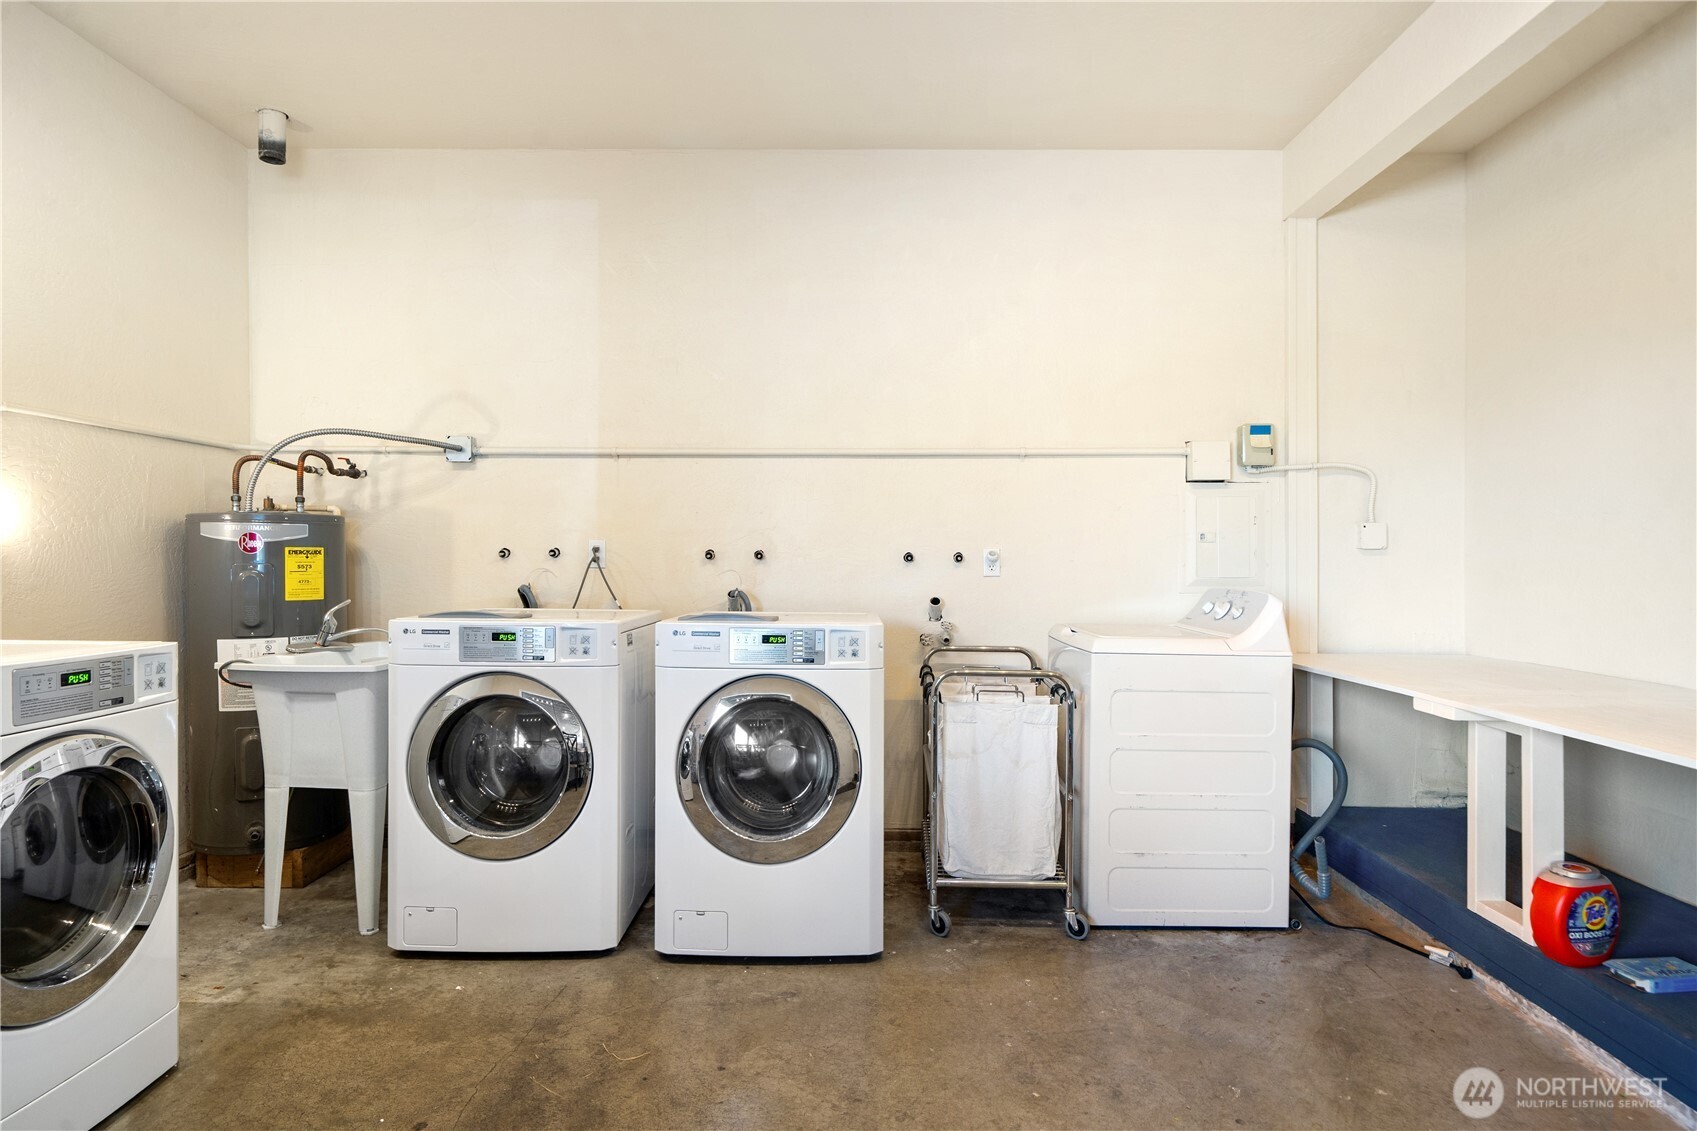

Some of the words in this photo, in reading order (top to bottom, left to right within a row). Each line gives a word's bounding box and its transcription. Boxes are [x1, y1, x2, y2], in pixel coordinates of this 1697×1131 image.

[68, 673, 89, 683] PUSH
[1586, 904, 1606, 923] Tide
[1584, 930, 1605, 939] BOOST
